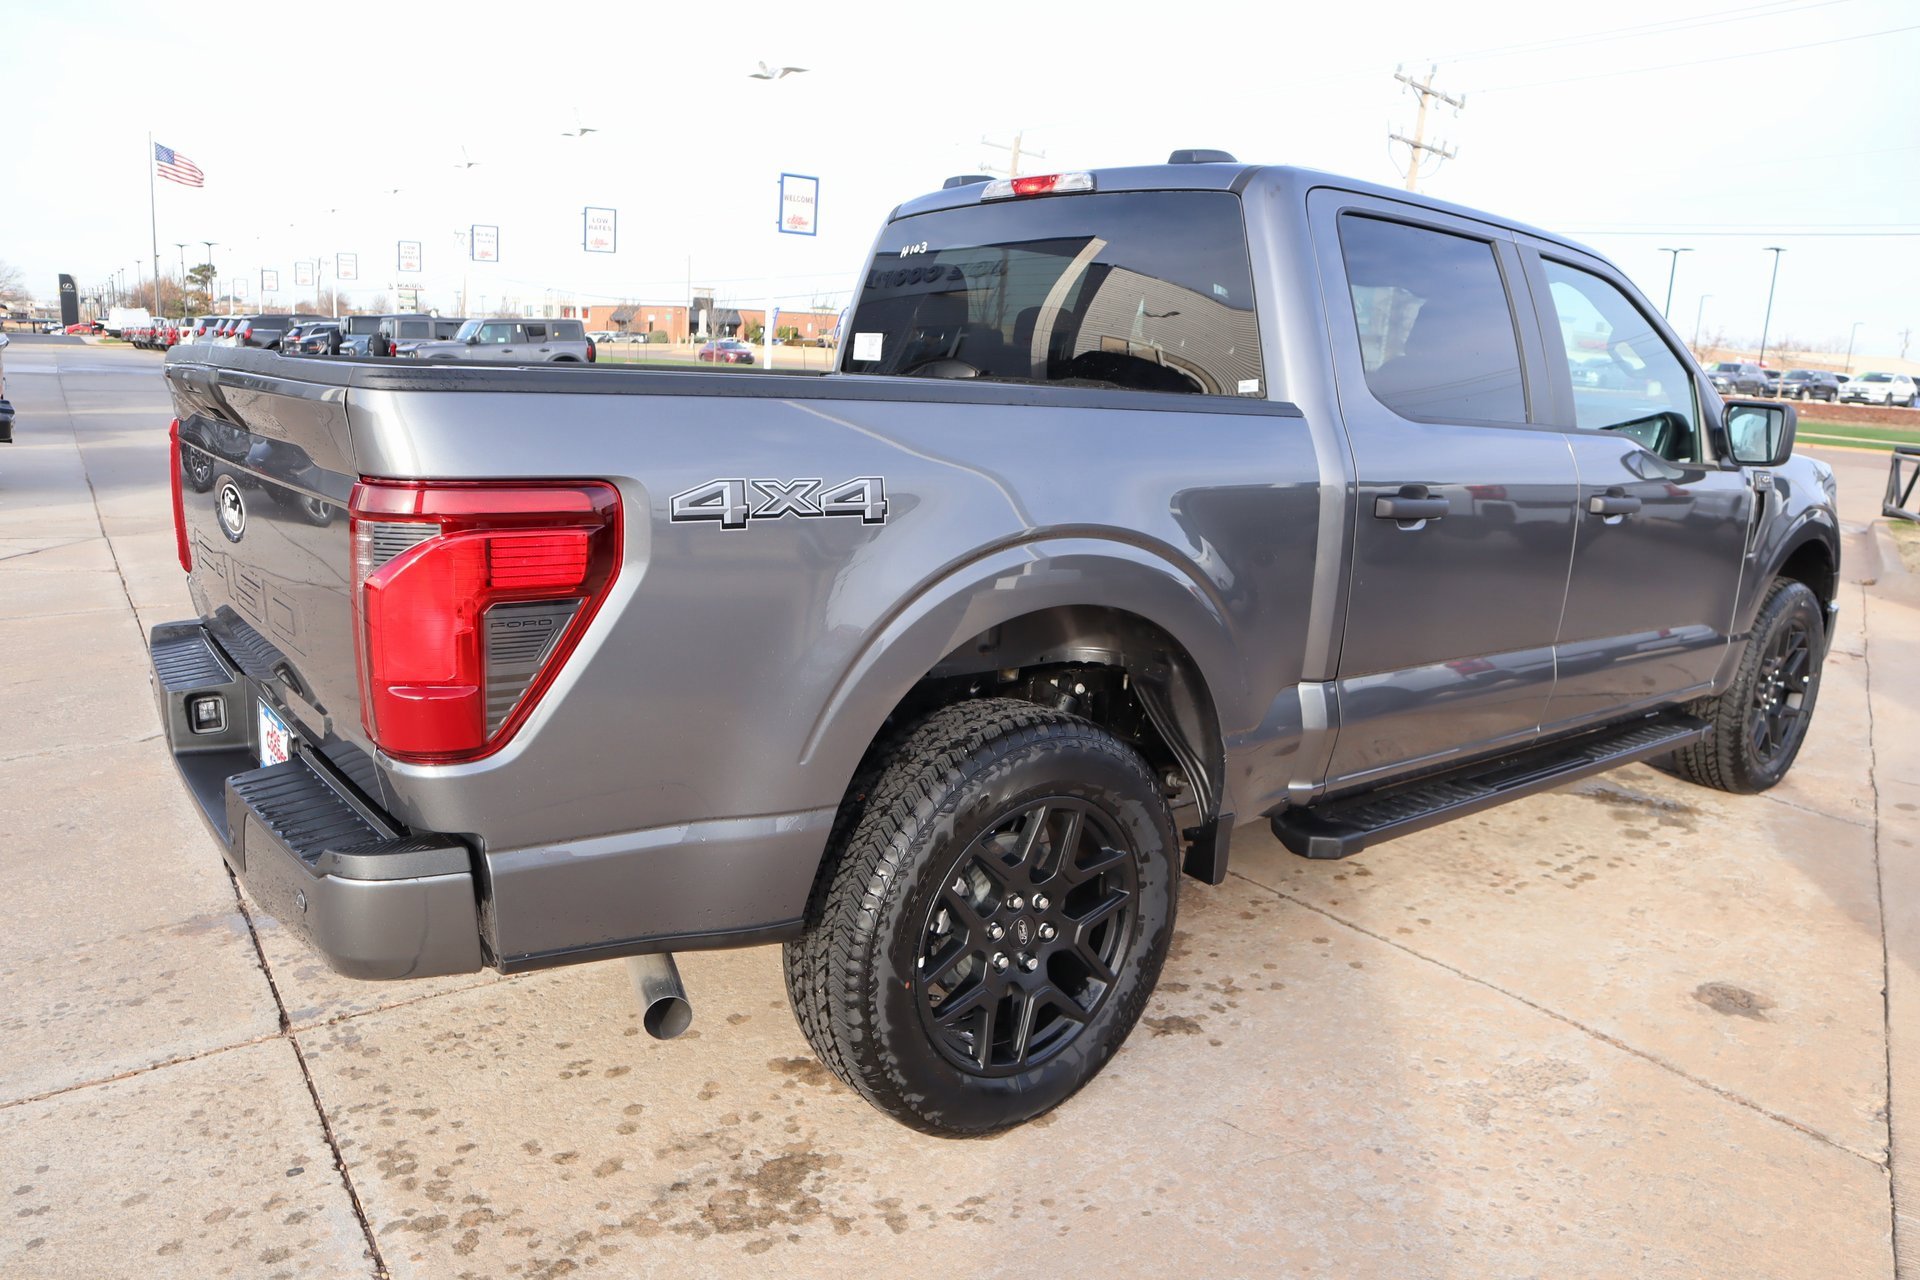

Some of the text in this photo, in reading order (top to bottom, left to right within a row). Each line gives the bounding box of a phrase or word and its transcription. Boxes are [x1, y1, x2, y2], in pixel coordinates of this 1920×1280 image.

[784, 194, 814, 204] WELCOME
[900, 241, 928, 258] H103
[223, 488, 241, 528] Ford
[669, 476, 889, 531] 4X4
[194, 527, 307, 658] F-150
[490, 618, 553, 629] FORD
